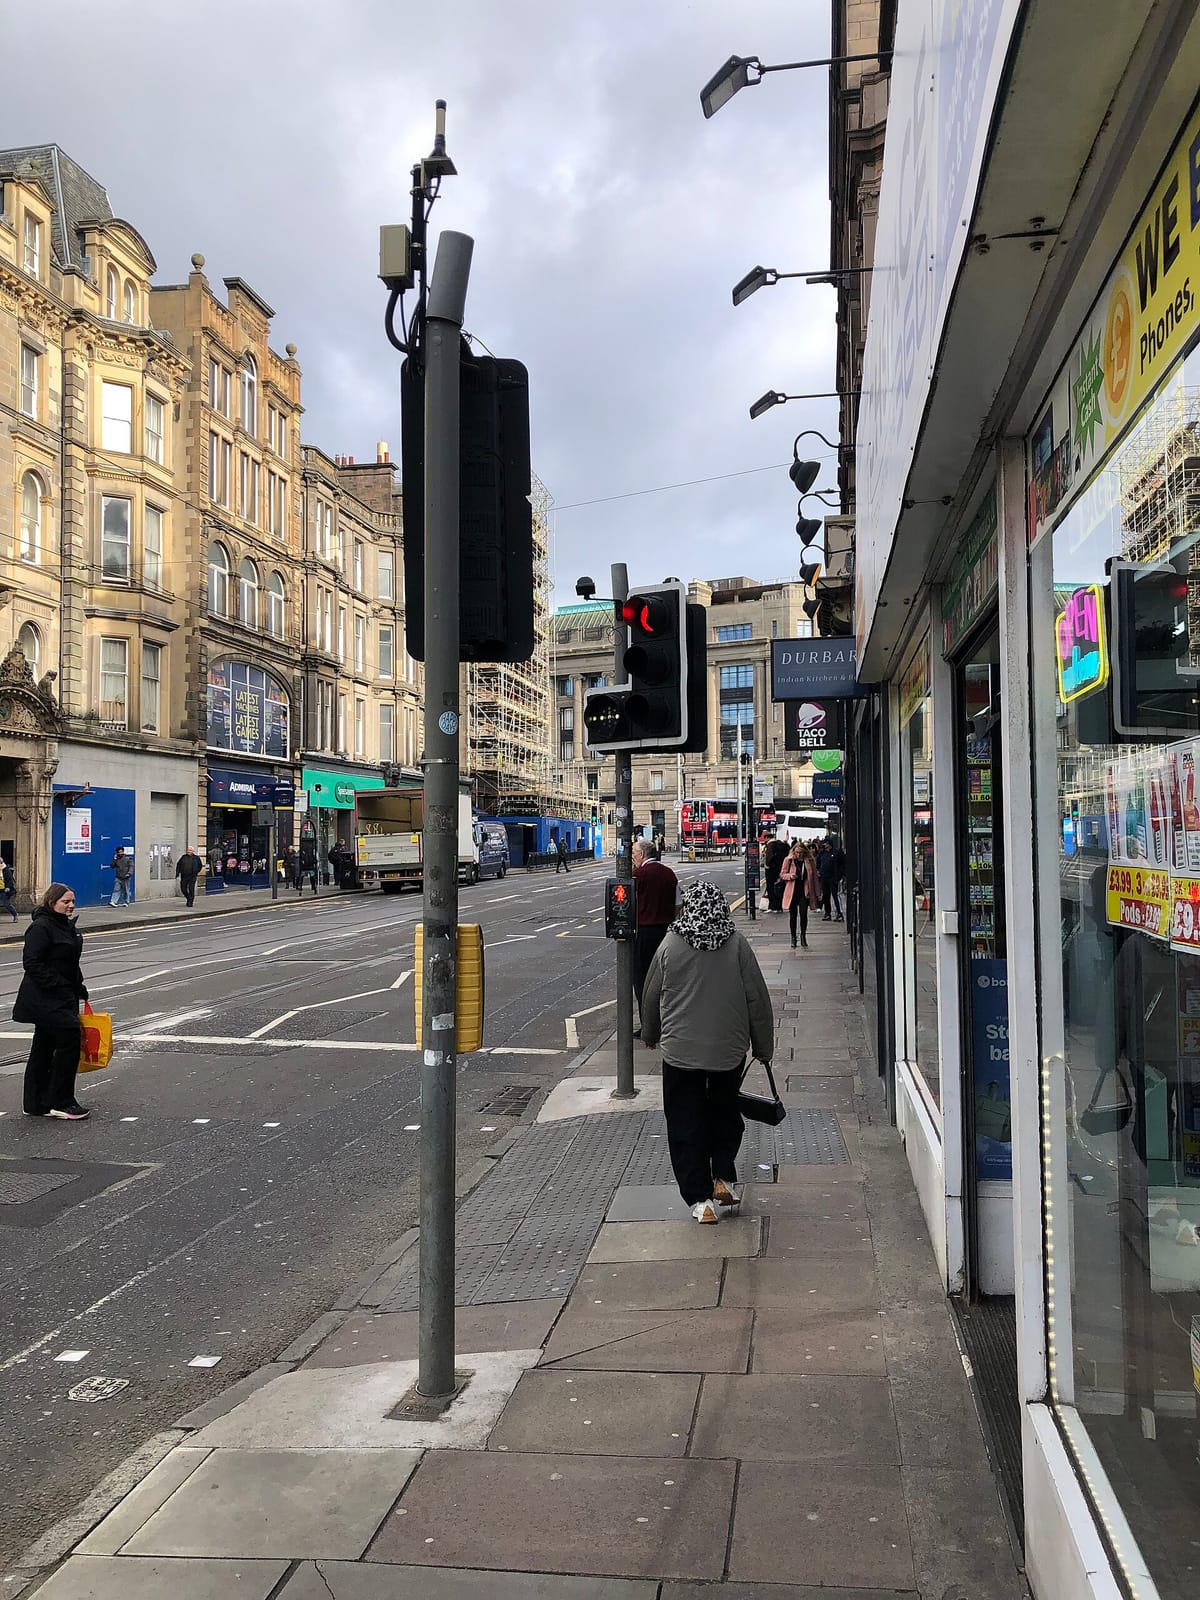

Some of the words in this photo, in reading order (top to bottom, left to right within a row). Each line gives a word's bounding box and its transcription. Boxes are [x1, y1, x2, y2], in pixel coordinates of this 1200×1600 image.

[1135, 171, 1181, 315] WE
[1140, 276, 1195, 377] Phones,
[1075, 357, 1099, 401] Instant
[1080, 393, 1097, 427] Cash
[781, 649, 857, 665] DURBAR
[235, 689, 260, 705] LATEST
[235, 712, 260, 728] LATEST
[235, 725, 260, 740] GAMES
[797, 728, 827, 738] TACO
[799, 737, 827, 747] BELL
[229, 781, 257, 794] ADMIRAL
[1120, 900, 1141, 924] Pods
